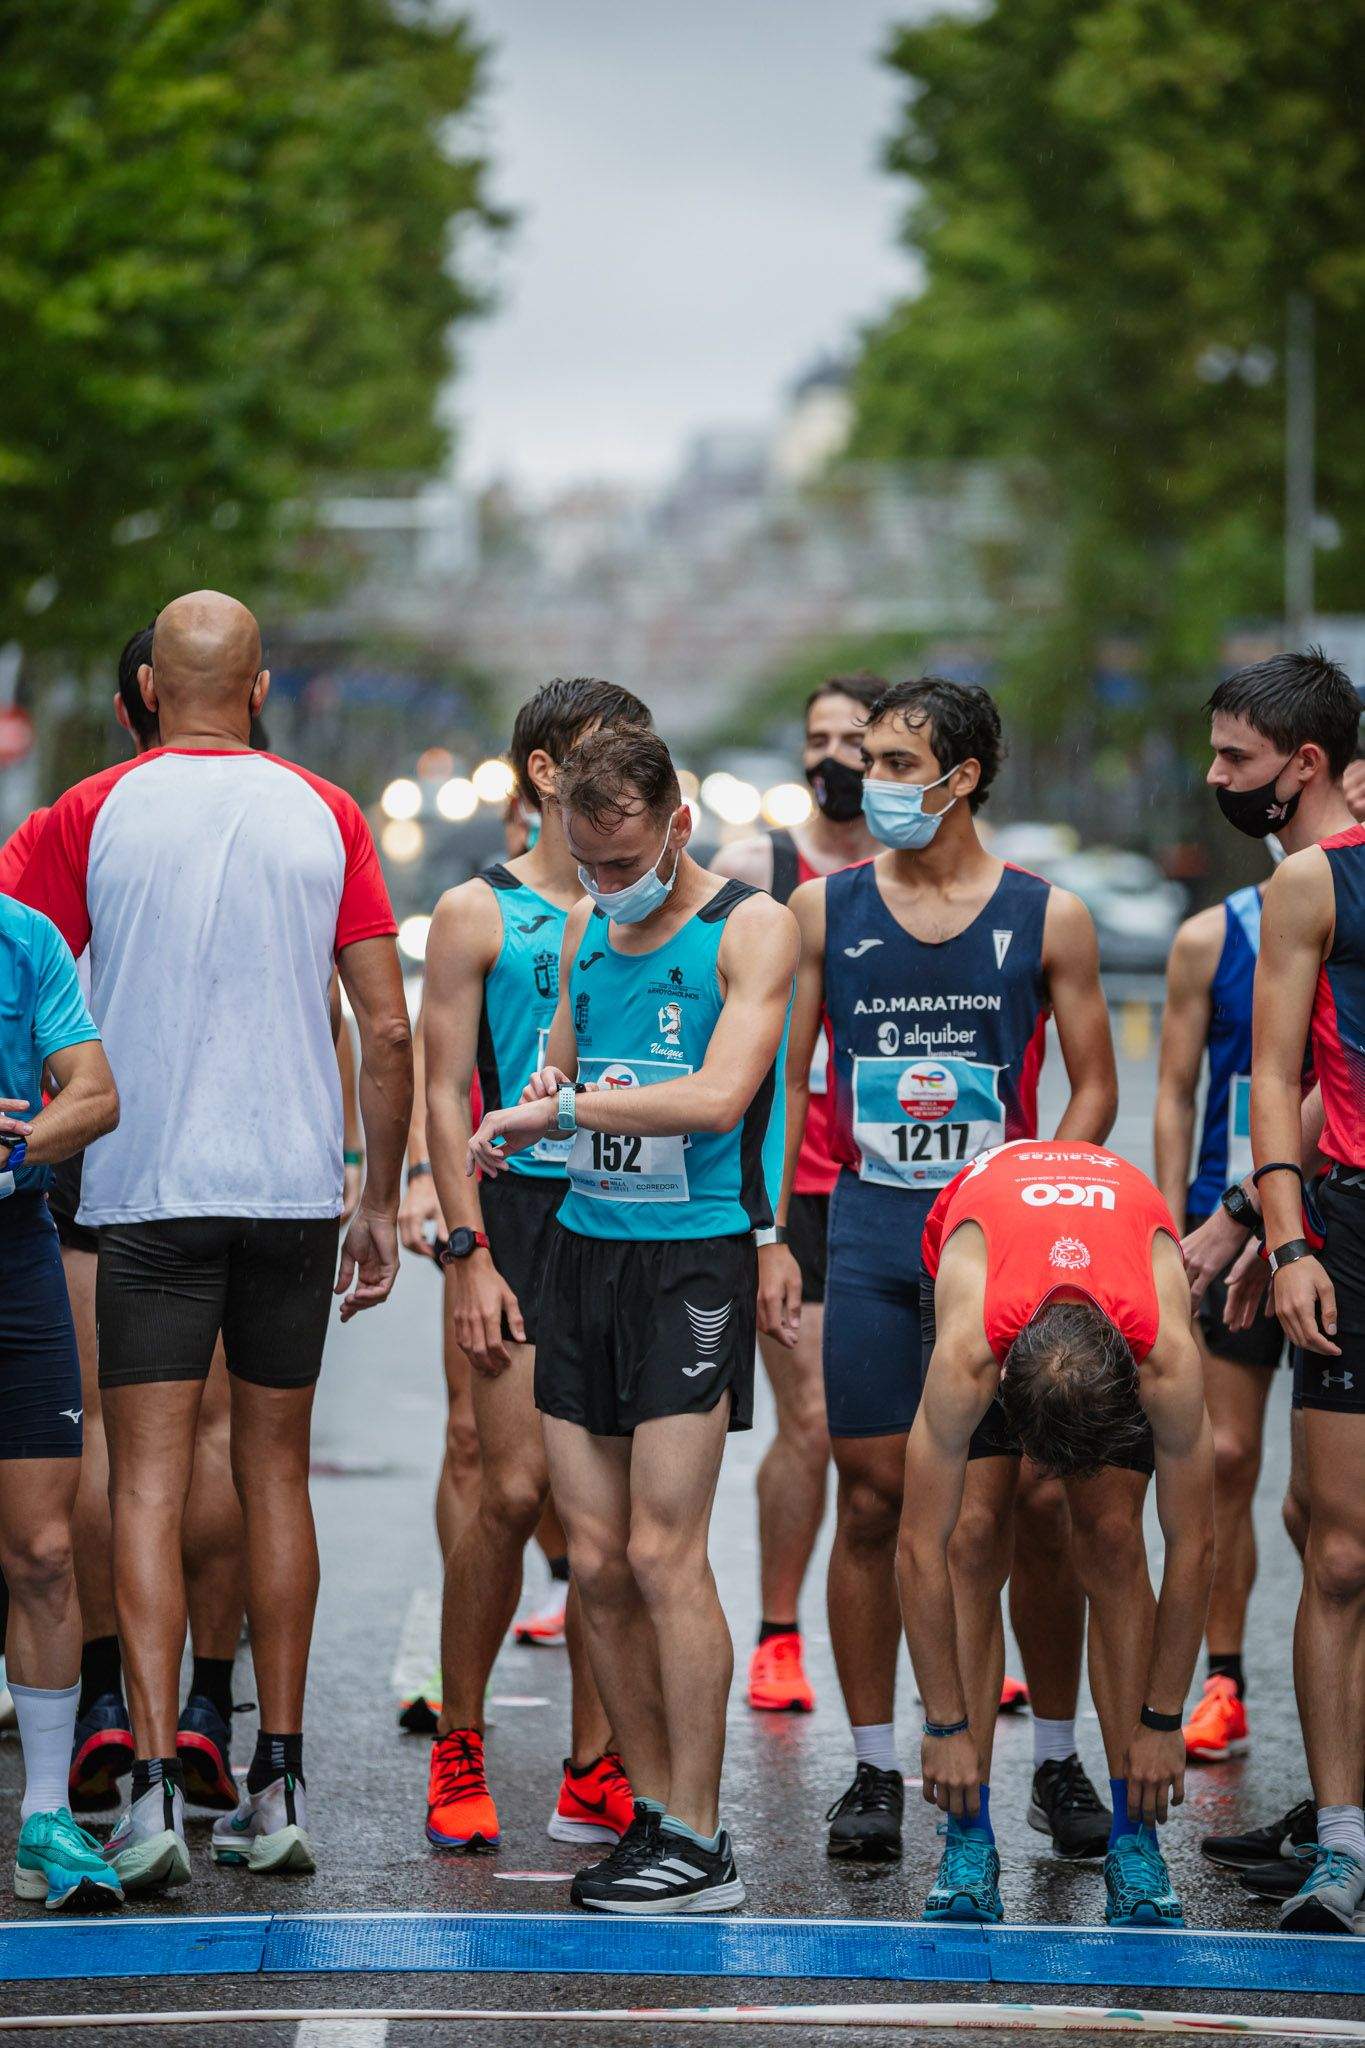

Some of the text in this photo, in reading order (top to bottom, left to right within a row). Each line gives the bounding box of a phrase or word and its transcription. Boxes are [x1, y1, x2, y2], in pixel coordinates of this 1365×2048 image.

[854, 995, 1001, 1015] A.D.MARATHON
[904, 1022, 977, 1054] alquiber
[591, 1132, 642, 1173] 152
[892, 1123, 969, 1162] 1217
